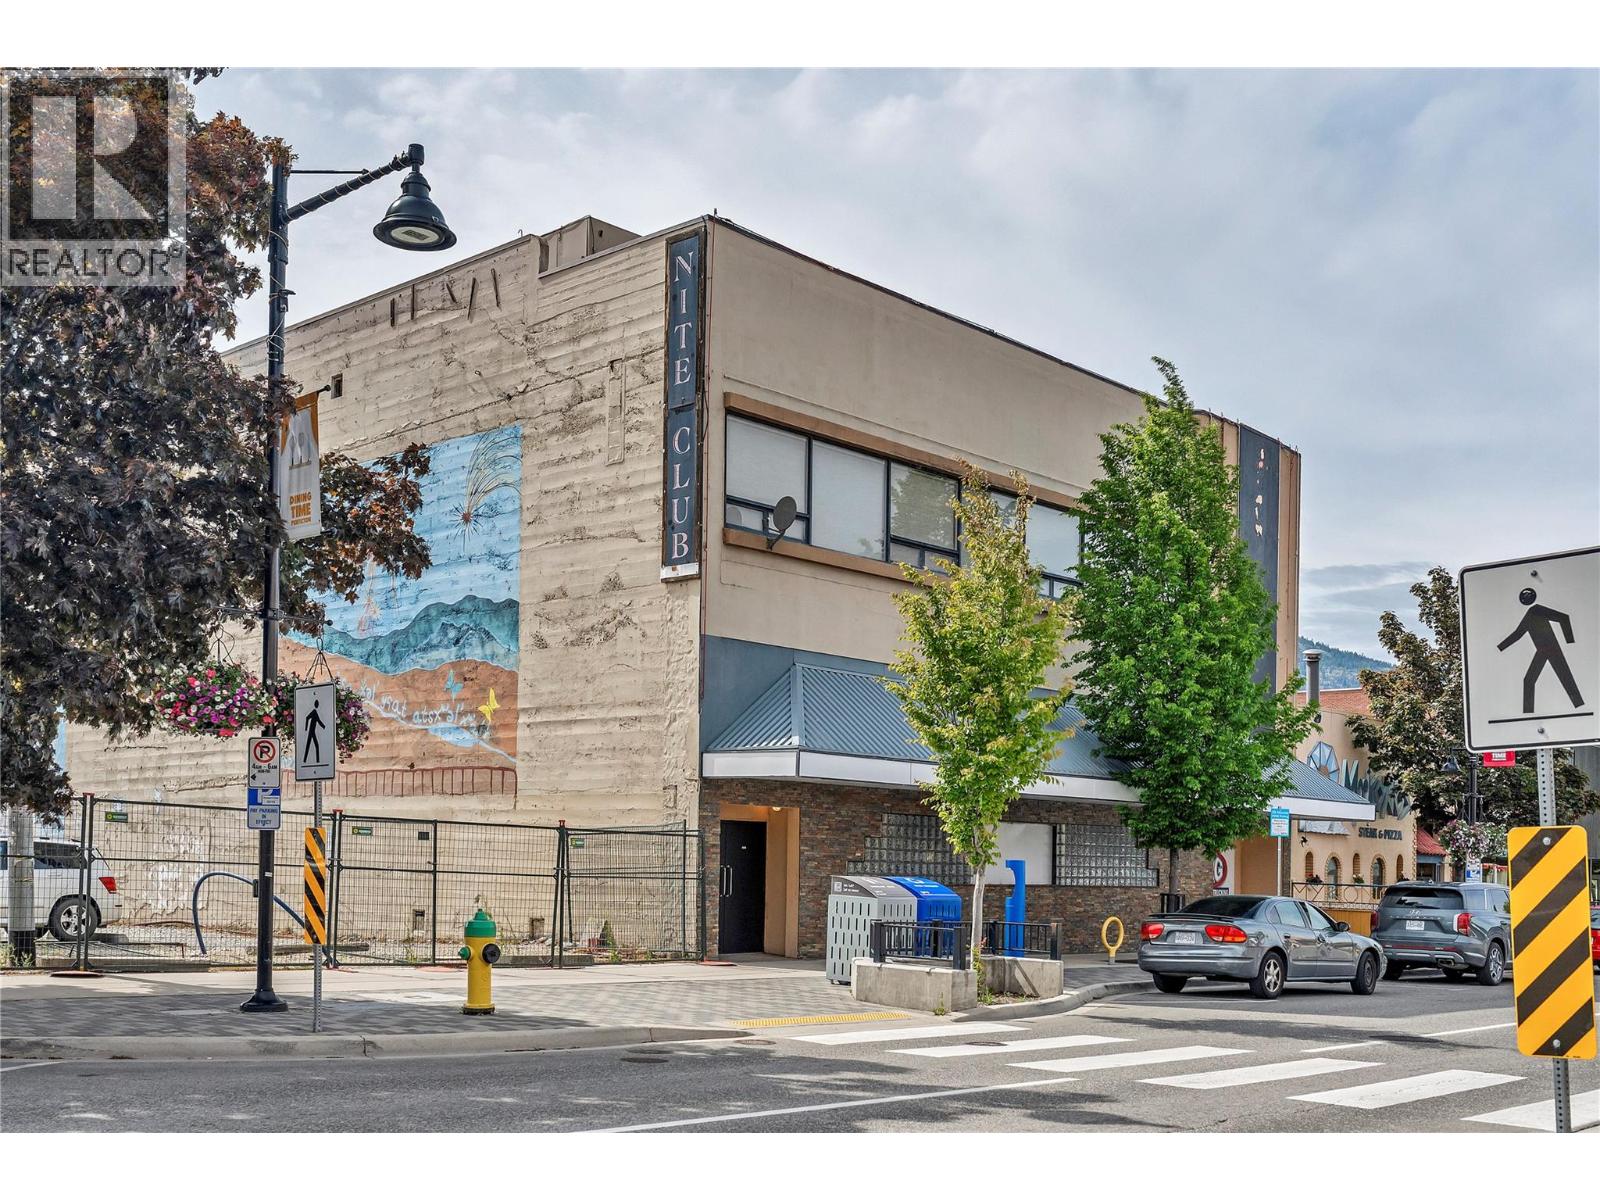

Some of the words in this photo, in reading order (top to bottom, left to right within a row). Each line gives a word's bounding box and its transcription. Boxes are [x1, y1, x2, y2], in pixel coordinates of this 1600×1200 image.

[674, 251, 694, 386] NITE
[290, 491, 311, 505] DINING
[672, 426, 691, 559] CLUB
[291, 503, 311, 518] TIME
[1359, 827, 1377, 838] STEAK
[1378, 830, 1383, 839] &
[1384, 829, 1402, 840] PIZZA
